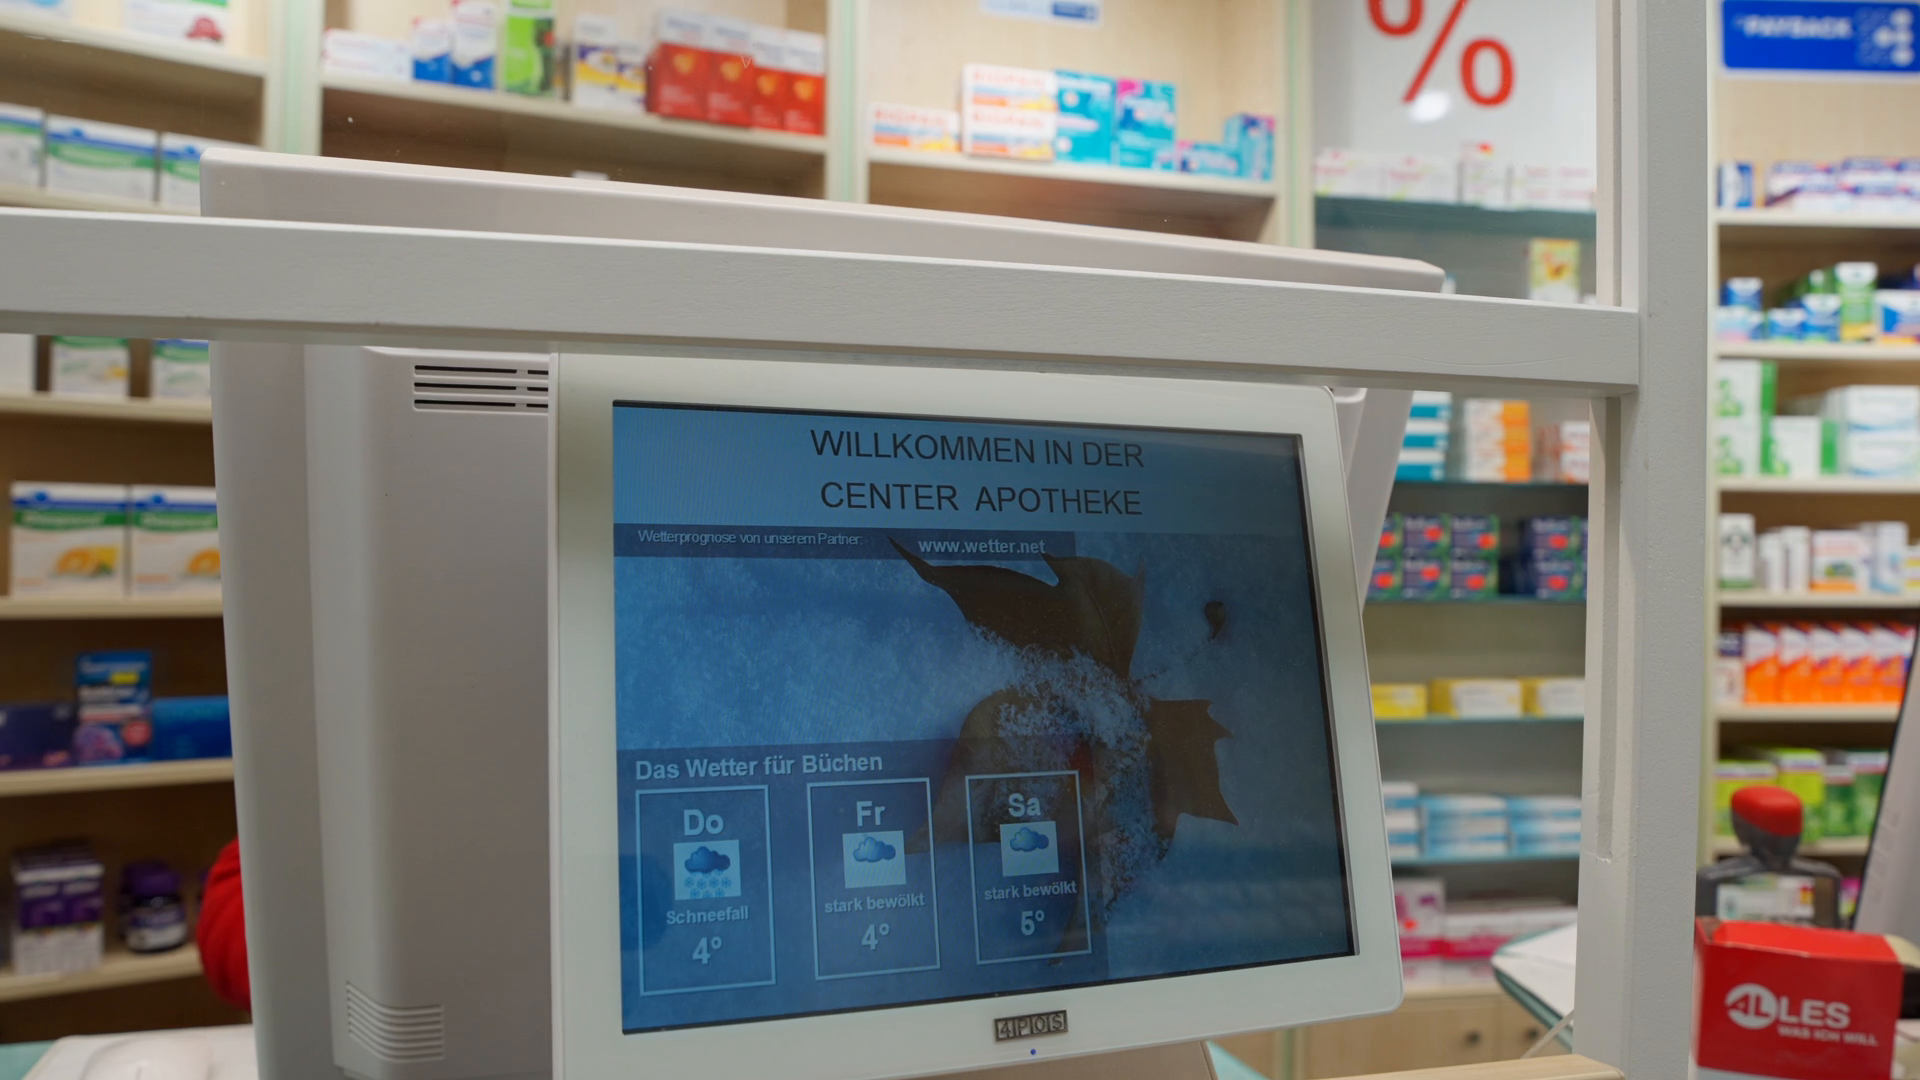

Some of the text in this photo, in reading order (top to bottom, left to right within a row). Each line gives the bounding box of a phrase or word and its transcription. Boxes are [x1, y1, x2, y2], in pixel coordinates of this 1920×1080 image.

[811, 430, 1145, 467] WILLKOMMEN IN DER
[820, 482, 1143, 515] CENTER APOTHEKE
[638, 530, 863, 546] Wetterprognose von unserem Partner:
[918, 537, 1046, 555] www.wetter.net
[635, 752, 883, 781] Das Wetter für Büchen
[856, 801, 886, 828] Fr
[1008, 793, 1042, 818] Sa
[683, 809, 724, 837] Do
[824, 892, 925, 914] stark bewölkt
[984, 881, 1077, 901] stark bewölkt
[665, 906, 749, 926] Schneefall
[692, 936, 723, 965] 4°
[861, 923, 890, 951] 4°
[998, 1011, 1065, 1038] 4POS
[1778, 1025, 1811, 1039] WAS
[1813, 1029, 1840, 1042] ICH
